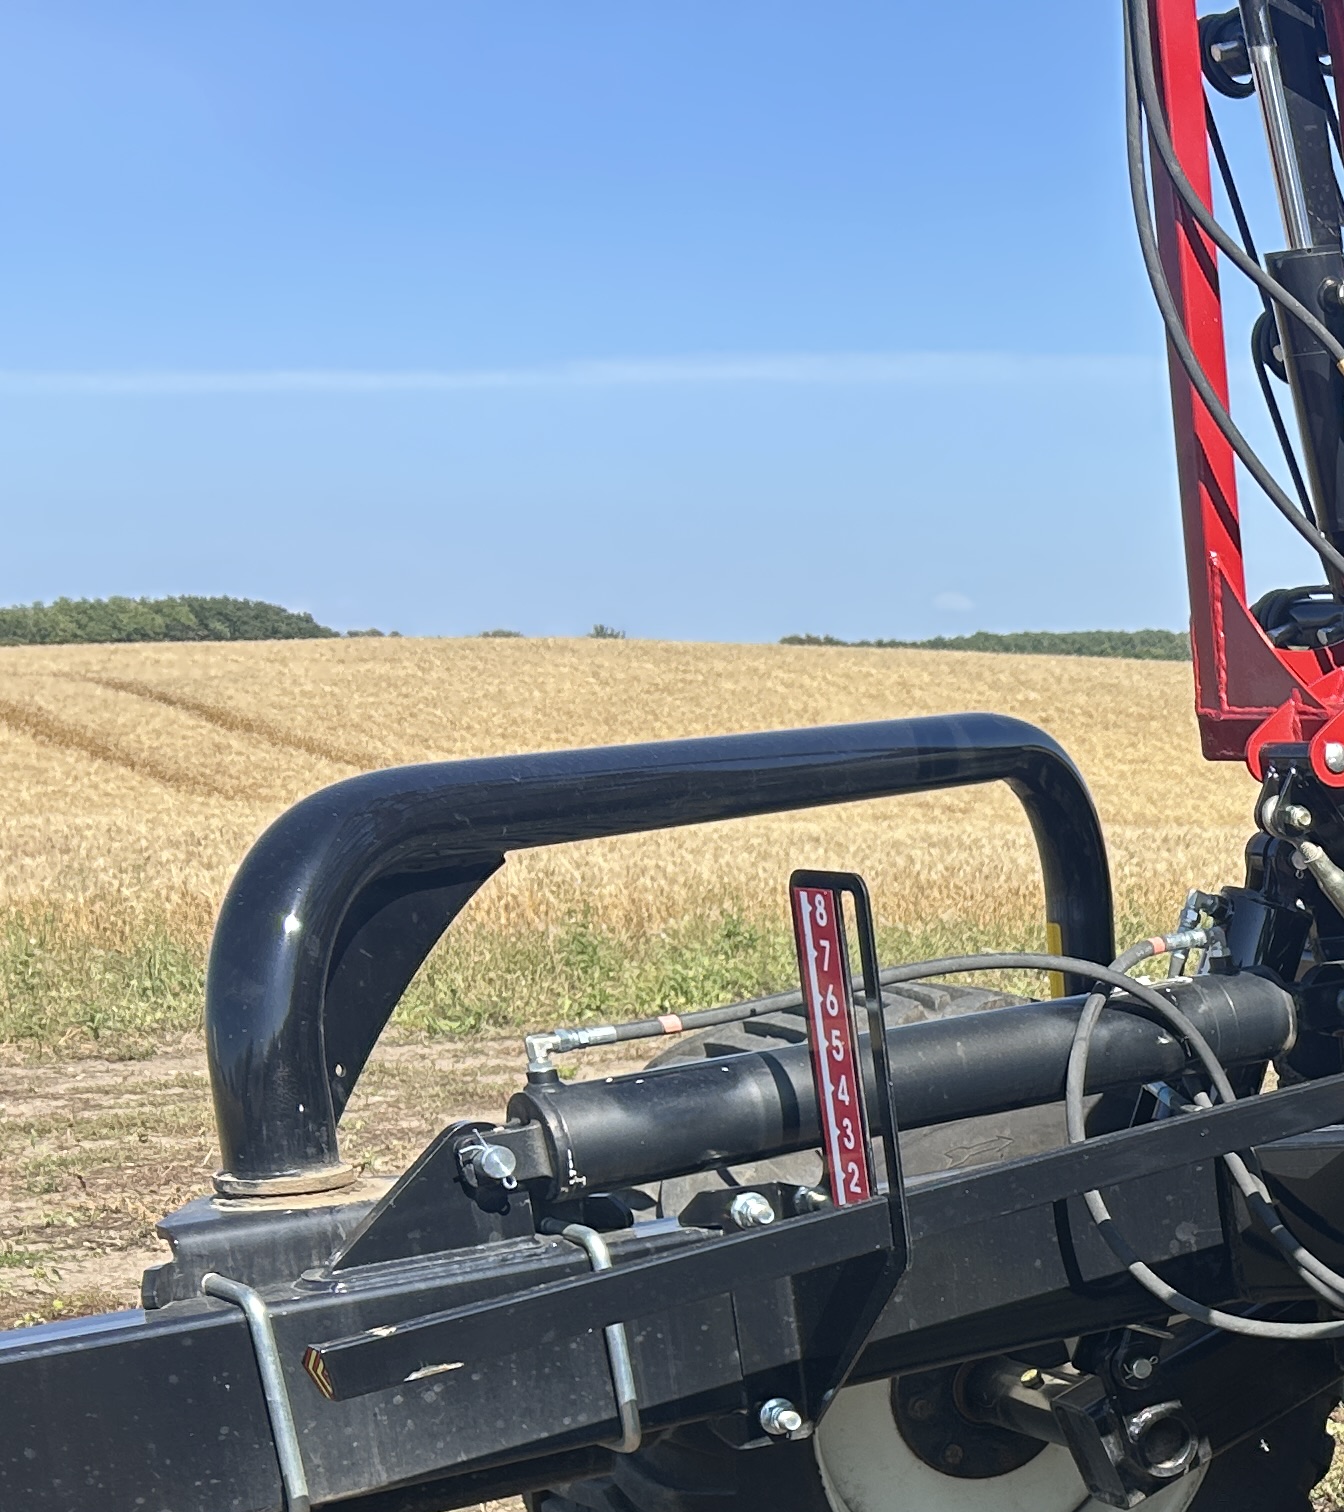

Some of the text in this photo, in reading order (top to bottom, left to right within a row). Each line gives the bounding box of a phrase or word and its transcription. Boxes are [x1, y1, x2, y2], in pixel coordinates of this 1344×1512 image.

[814, 893, 828, 927] 8
[819, 940, 830, 971] 7
[826, 984, 838, 1017] 6
[831, 1029, 845, 1061] 5
[837, 1075, 849, 1105] 4
[842, 1117, 855, 1150] 3
[847, 1162, 862, 1194] 2
